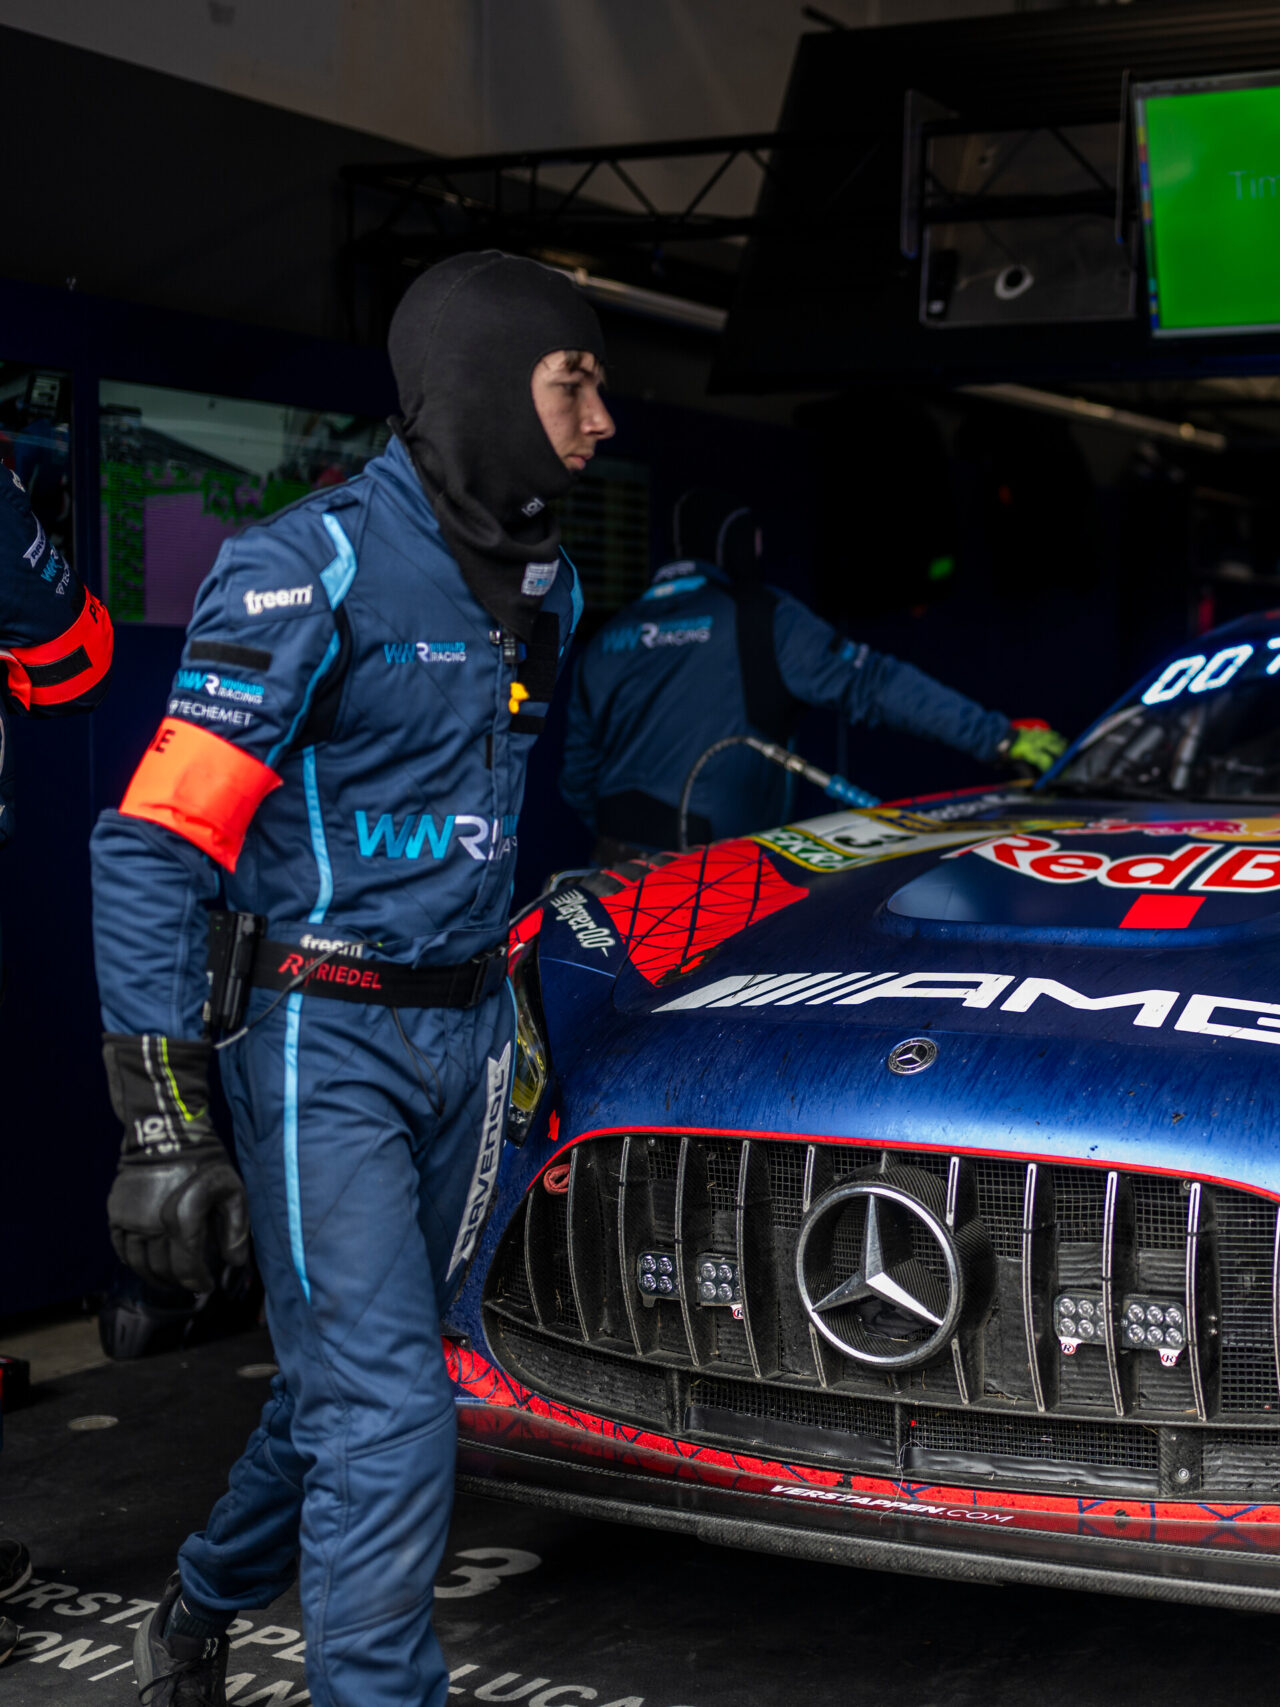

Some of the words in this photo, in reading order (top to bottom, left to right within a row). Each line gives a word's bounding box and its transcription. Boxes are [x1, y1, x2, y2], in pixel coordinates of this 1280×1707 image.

[243, 584, 313, 616] freem
[178, 700, 254, 727] TECHEMET
[942, 833, 1222, 890] Red
[315, 961, 383, 990] RIEDEL
[769, 1484, 1015, 1523] VERSTAPPEN.COM
